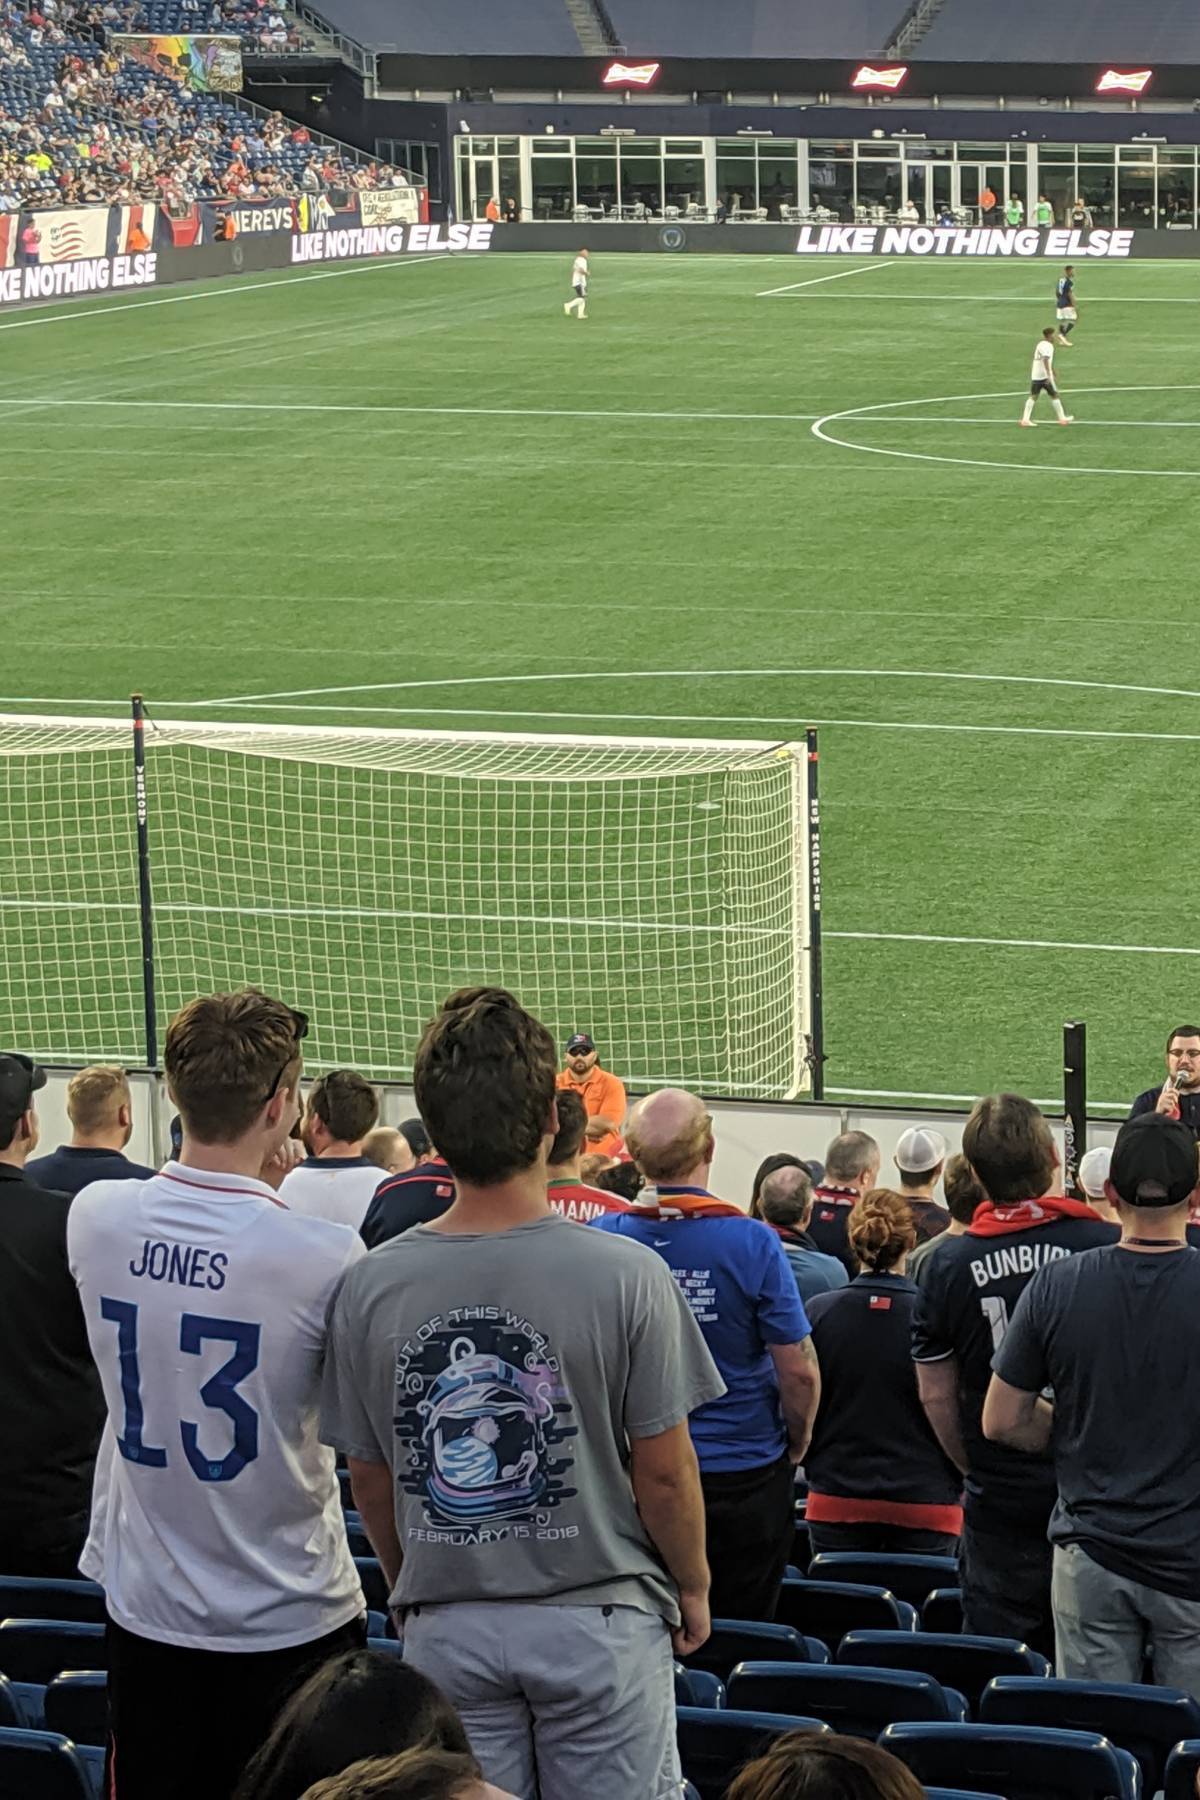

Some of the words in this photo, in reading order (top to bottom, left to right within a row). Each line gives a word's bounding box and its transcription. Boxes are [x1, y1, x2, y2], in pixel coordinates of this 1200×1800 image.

[291, 232, 325, 262] LIKE
[325, 225, 403, 258] NOTHING
[407, 224, 494, 251] ELSE
[797, 226, 878, 254] LIKE
[881, 227, 1040, 256] NOTHING
[1043, 229, 1135, 257] ELSE
[24, 259, 109, 298] NOTHING
[113, 253, 157, 286] ELSE
[130, 1239, 229, 1291] JONES
[394, 1340, 415, 1384] OUT
[416, 1315, 443, 1342] OF
[448, 1305, 500, 1323] THIS
[505, 1311, 560, 1373] WORLD
[100, 1295, 262, 1482] 13
[407, 1527, 507, 1546] FEBRUARY
[536, 1525, 580, 1540] 2018
